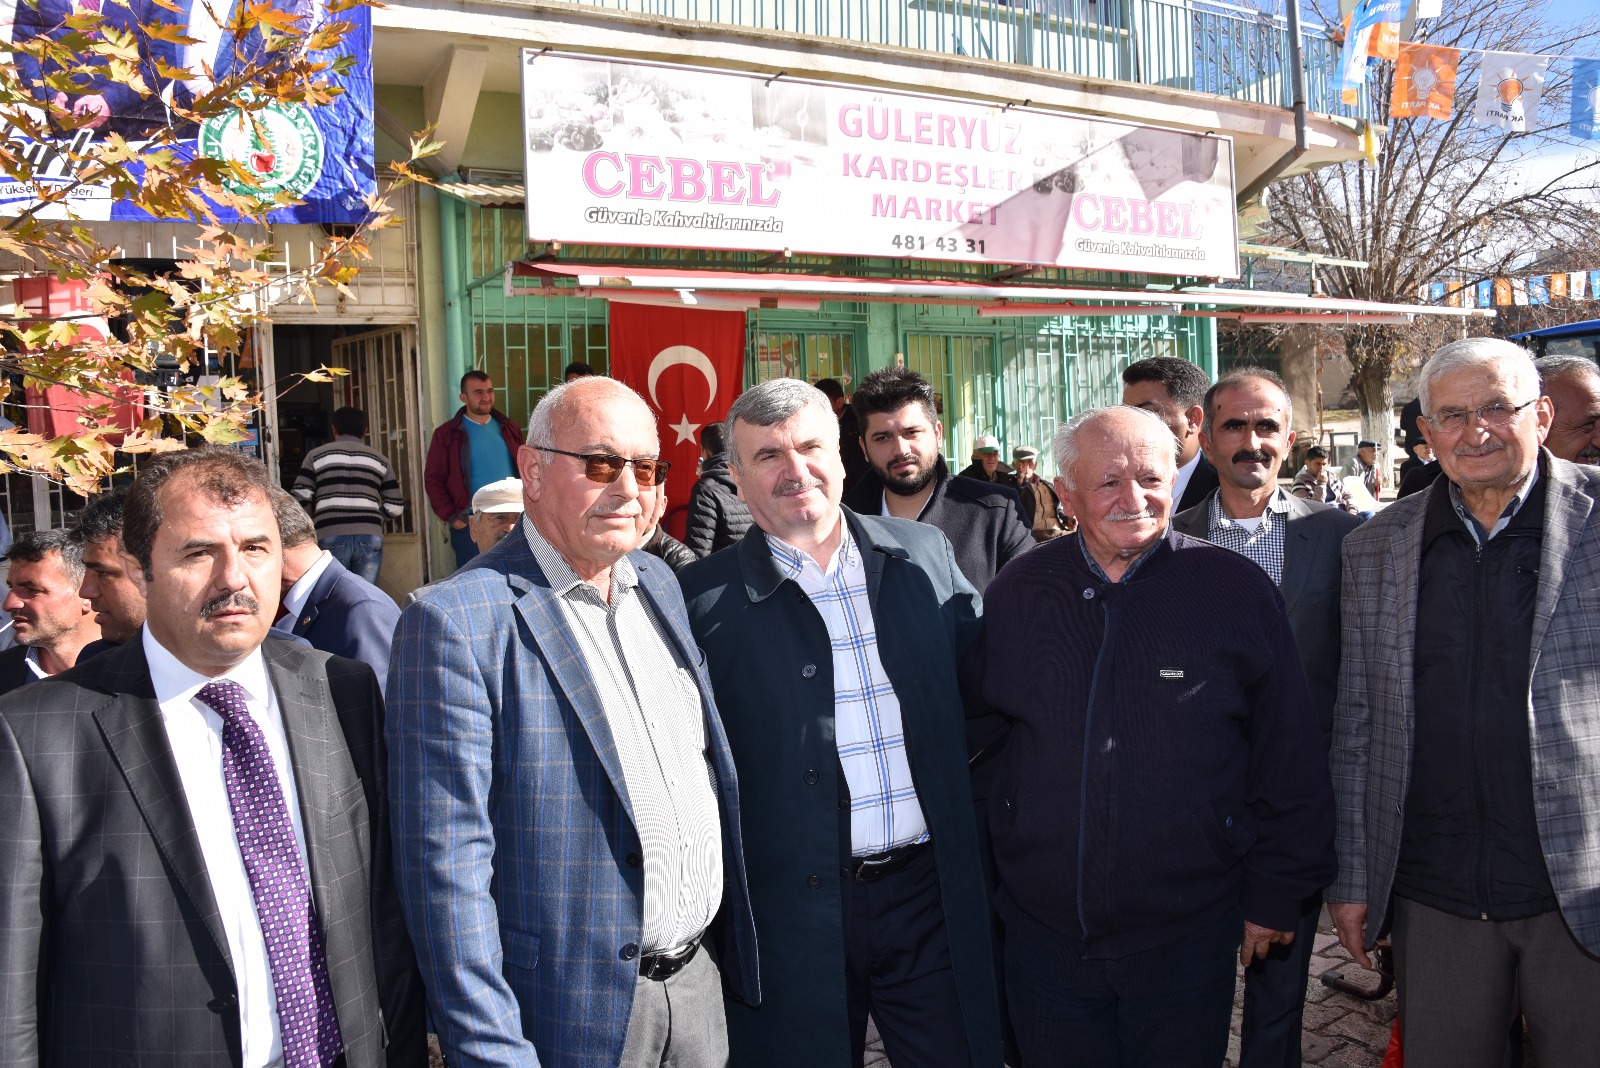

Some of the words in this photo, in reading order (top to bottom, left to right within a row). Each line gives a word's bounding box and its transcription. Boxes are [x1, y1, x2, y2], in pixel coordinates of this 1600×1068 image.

[837, 96, 1022, 155] GÜLERYÜZ
[582, 151, 781, 208] CEBEL
[842, 152, 1023, 194] KARDEŞLER
[584, 207, 651, 226] Güvenle
[652, 210, 784, 234] Kahvaltılarınızda
[871, 193, 1001, 226] MARKET
[1072, 193, 1204, 240] CEBEL
[891, 234, 926, 251] 481
[935, 236, 958, 252] 43
[965, 238, 986, 255] 31
[1075, 238, 1119, 255] Güvenle
[1120, 241, 1206, 261] Kahvaltılarınızda
